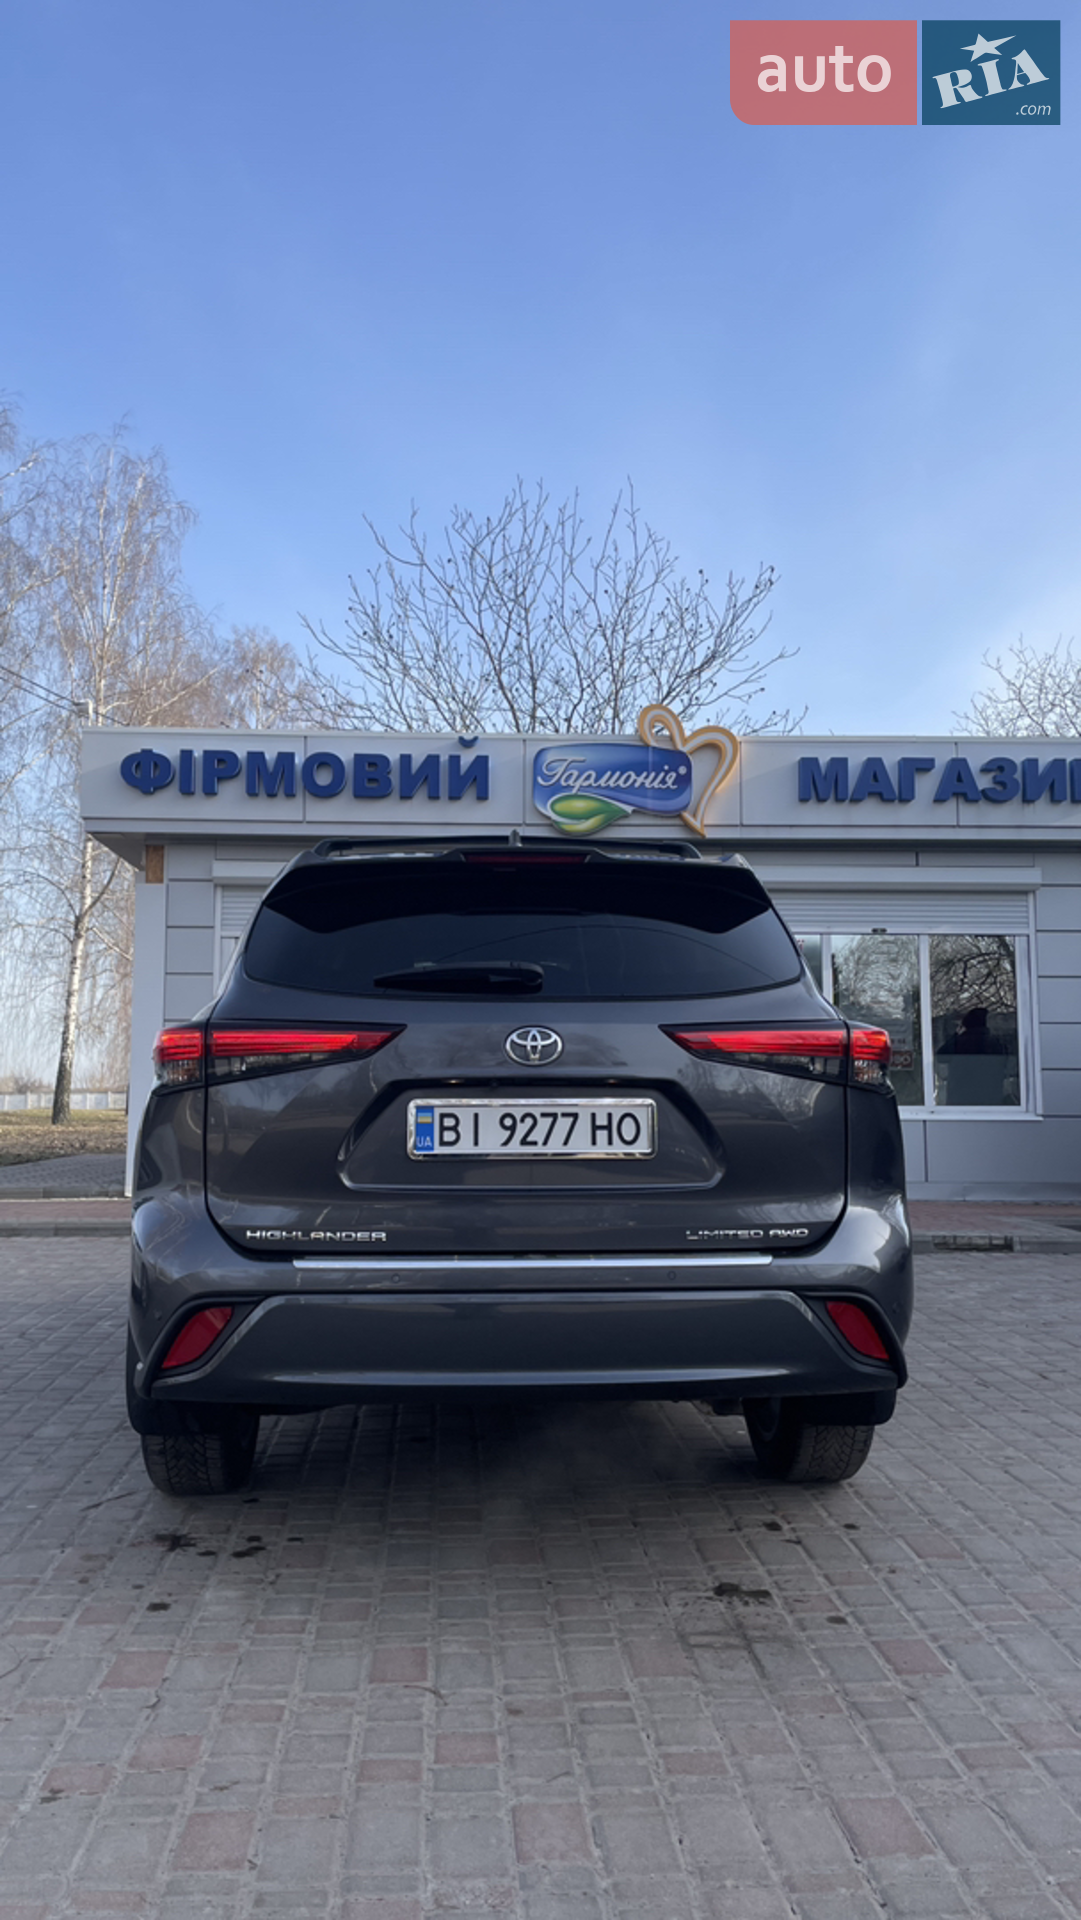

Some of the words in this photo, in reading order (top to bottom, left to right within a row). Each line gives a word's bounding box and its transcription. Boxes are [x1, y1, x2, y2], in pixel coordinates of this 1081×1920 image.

[120, 735, 491, 801] ФІРМОВИЙ
[536, 756, 678, 793] Гармонія
[798, 757, 1081, 804] МАГАЗИ
[415, 1136, 433, 1148] UA
[438, 1112, 479, 1147] BI
[499, 1112, 579, 1147] 9277
[590, 1112, 641, 1147] HO
[246, 1229, 387, 1242] HIGHLANDER
[686, 1229, 764, 1240] LIMITED
[769, 1228, 809, 1239] AWD
